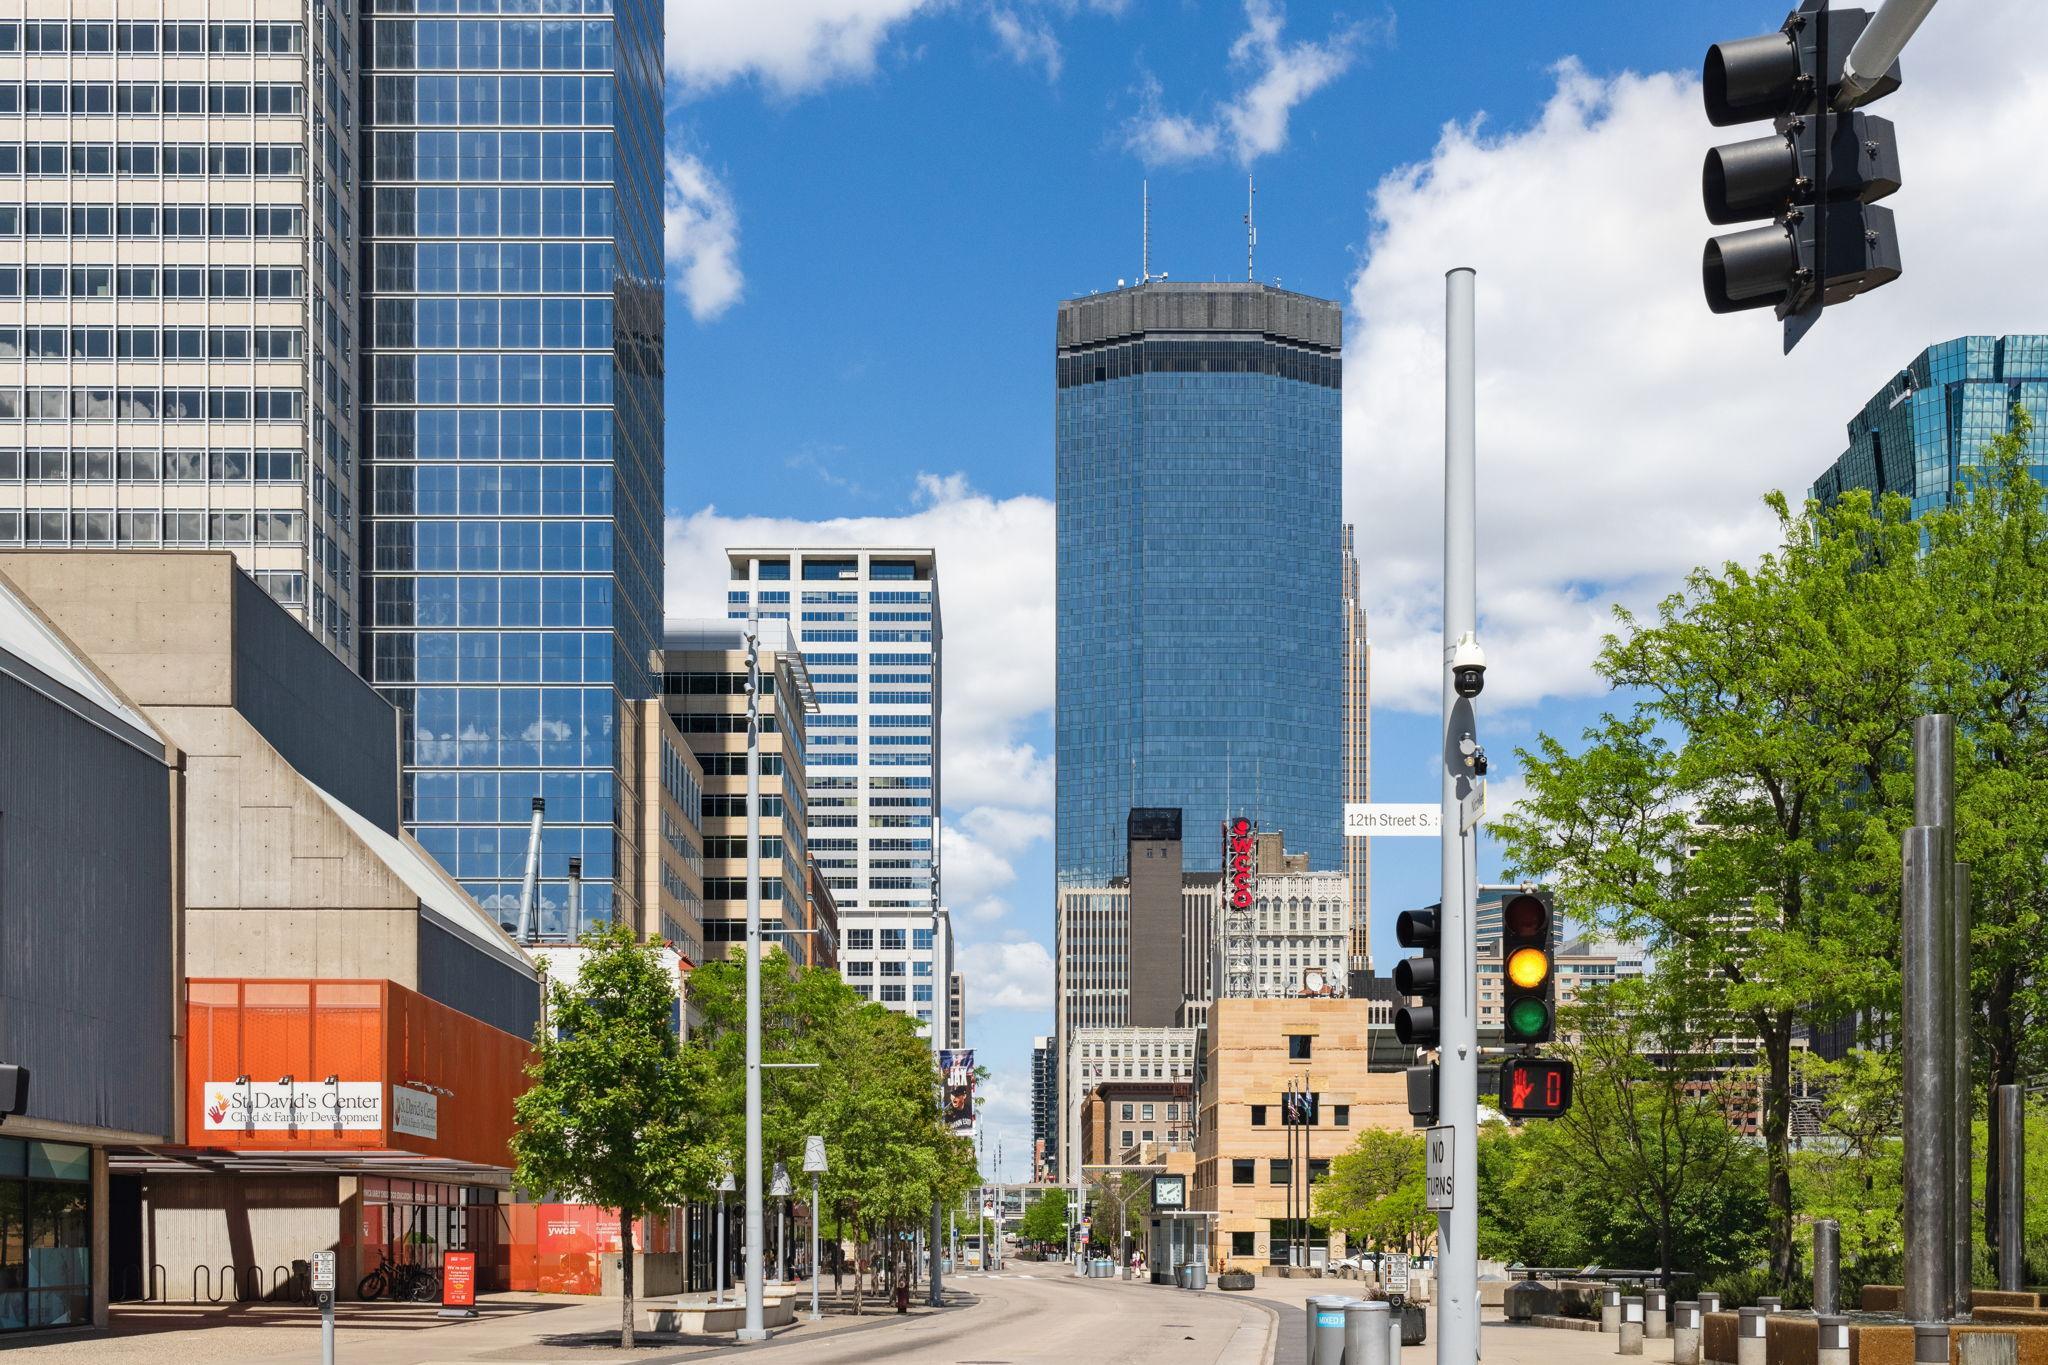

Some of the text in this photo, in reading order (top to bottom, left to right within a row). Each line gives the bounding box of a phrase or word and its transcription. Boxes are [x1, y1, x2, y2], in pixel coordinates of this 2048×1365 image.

[1348, 813, 1377, 826] 12th
[1379, 813, 1416, 826] Street
[1419, 813, 1431, 826] S.
[1231, 837, 1254, 908] WCCO
[947, 1067, 968, 1086] JAX
[1547, 1071, 1561, 1106] 0
[255, 1092, 317, 1109] David's
[322, 1092, 379, 1109] Center
[261, 1112, 272, 1122] &
[274, 1111, 309, 1125] Family
[311, 1111, 379, 1125] Development
[1432, 1141, 1444, 1164] NO
[1427, 1176, 1453, 1196] TURNS
[548, 1227, 576, 1237] ywca
